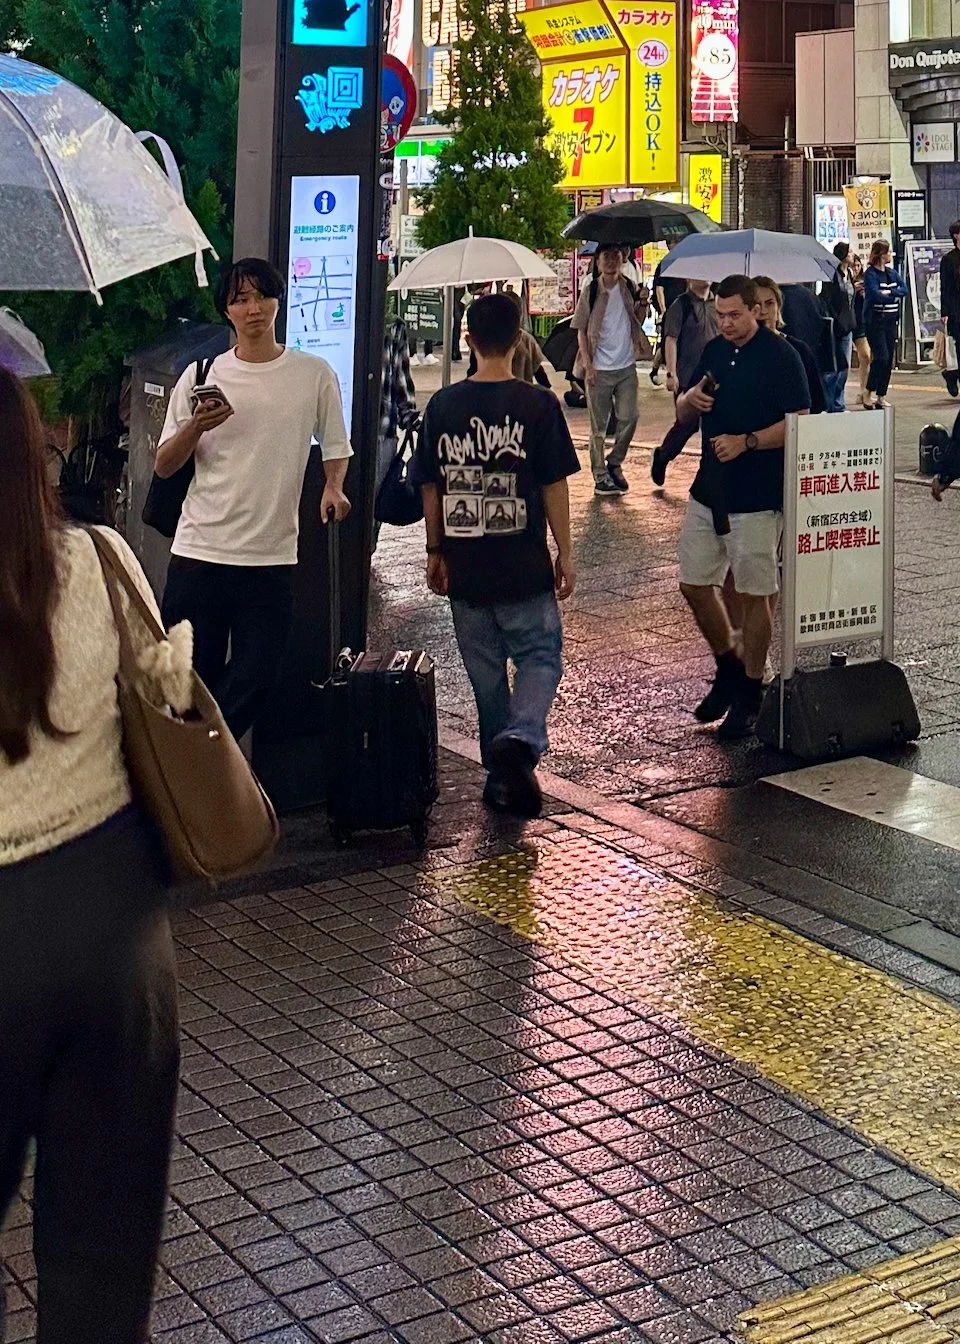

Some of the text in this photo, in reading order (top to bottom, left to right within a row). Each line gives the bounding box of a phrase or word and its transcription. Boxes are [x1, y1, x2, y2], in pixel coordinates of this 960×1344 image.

[617, 9, 673, 27] カラオケ
[889, 54, 915, 69] Don
[548, 63, 620, 107] カラオケ
[799, 470, 880, 497] 車両進入禁止
[806, 509, 872, 528] (新宿区内全域)
[797, 525, 880, 555] 路上喫煙禁止
